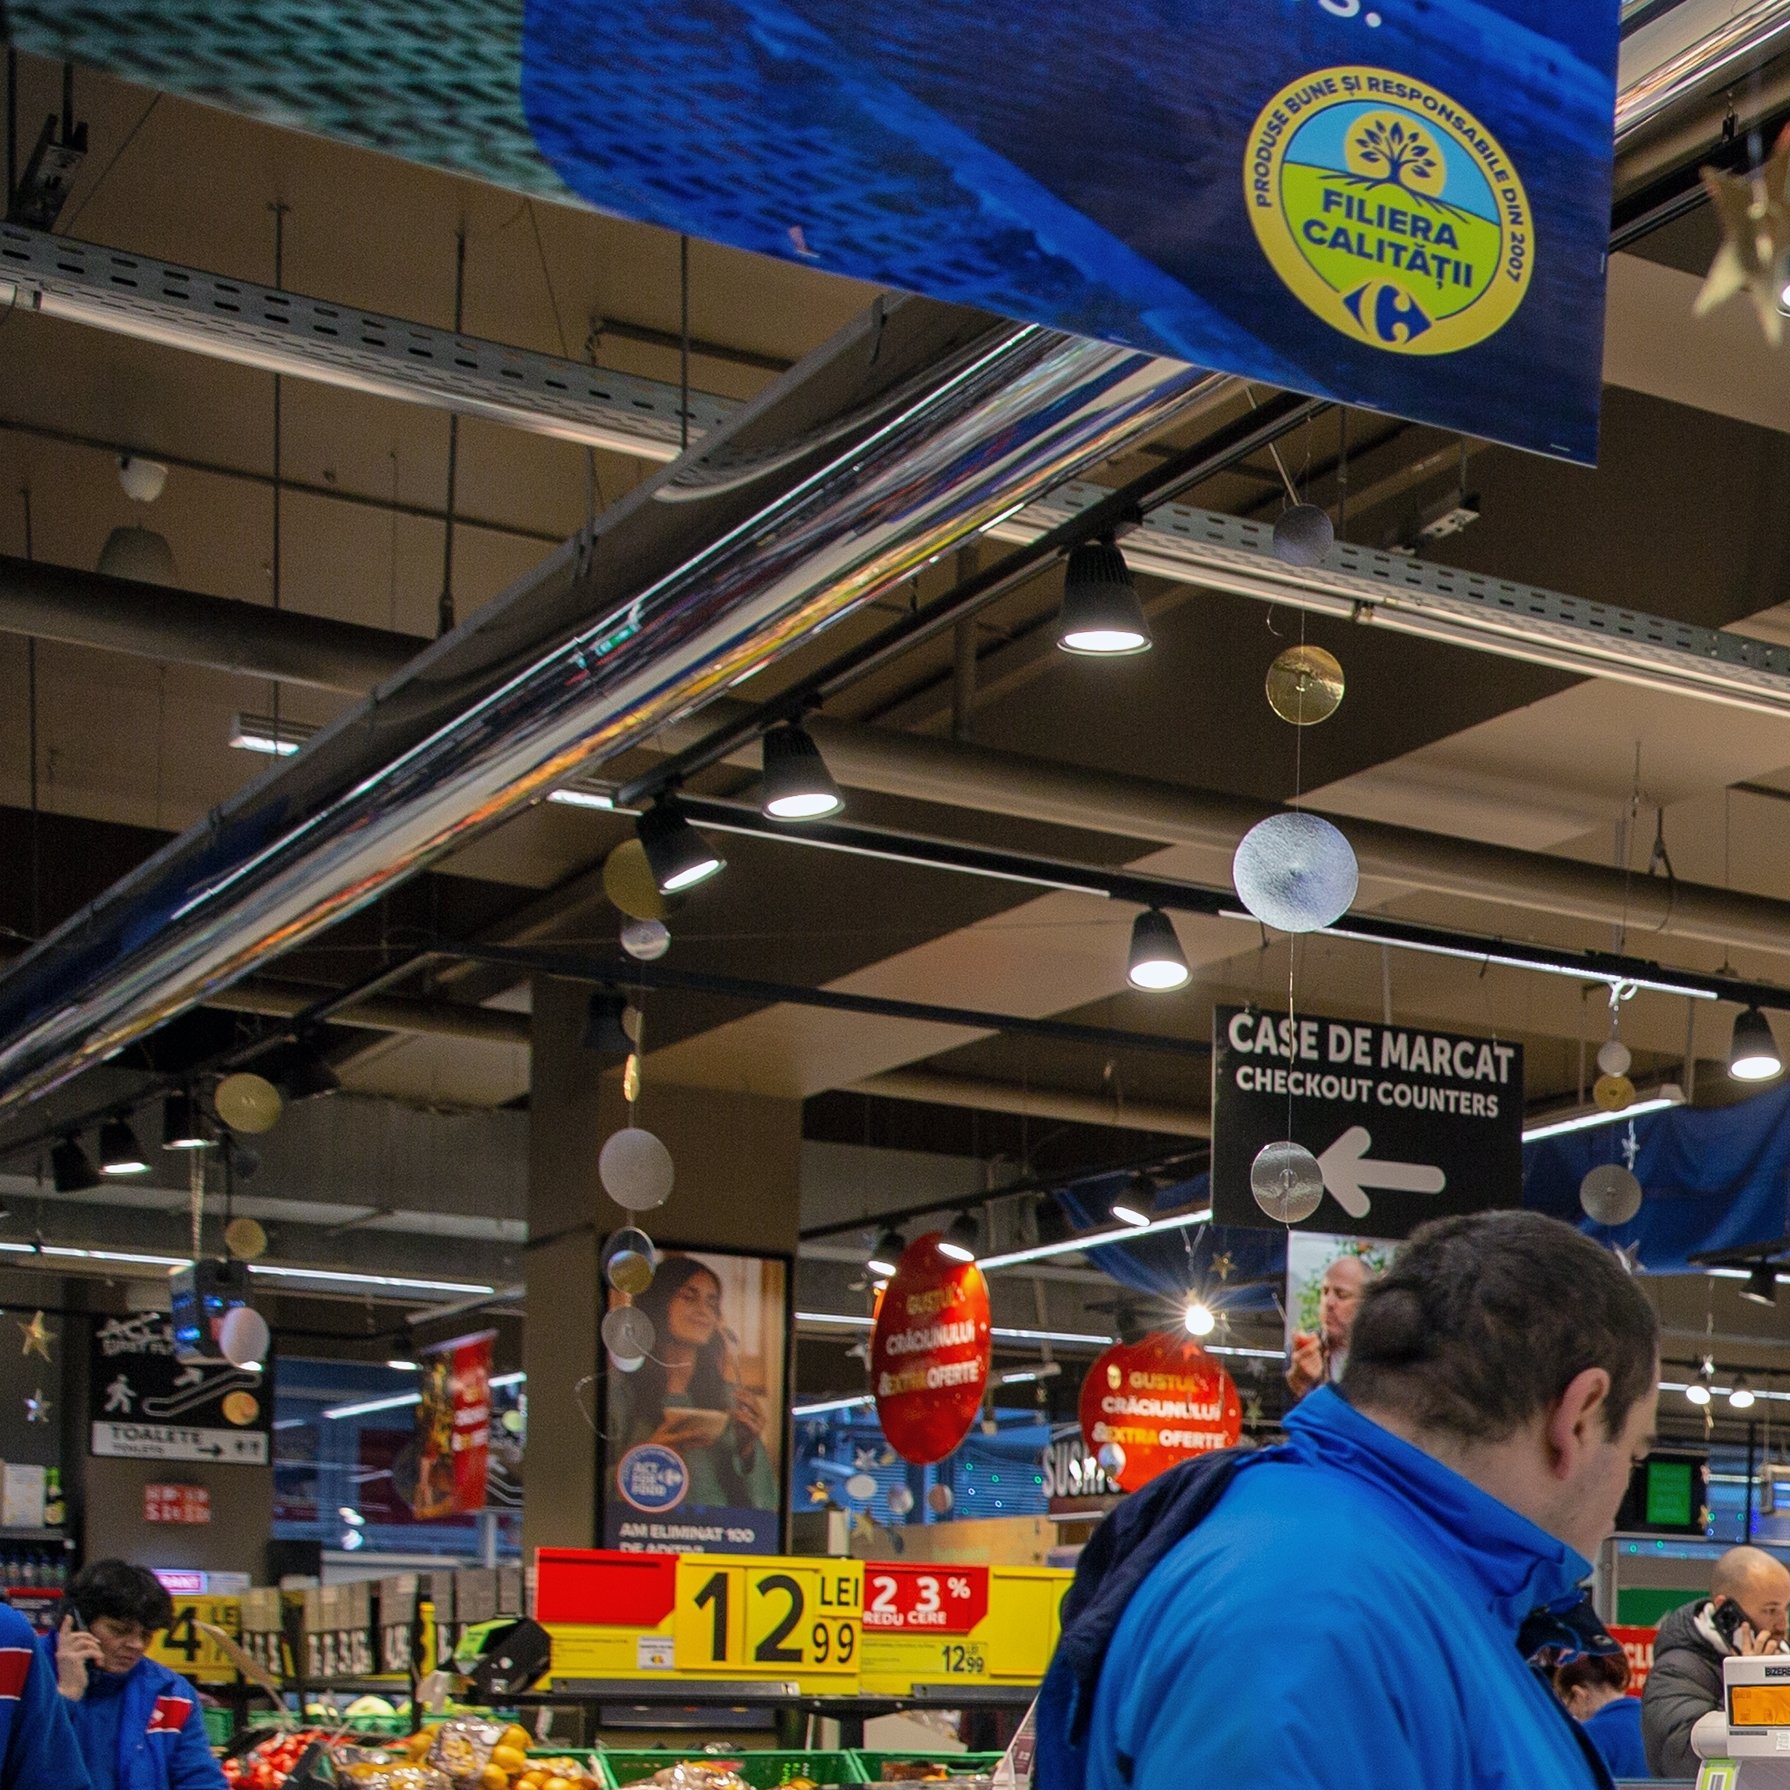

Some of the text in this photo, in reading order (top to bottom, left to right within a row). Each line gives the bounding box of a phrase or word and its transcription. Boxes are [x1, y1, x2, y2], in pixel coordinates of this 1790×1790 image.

[1286, 76, 1338, 115] BUNE
[1254, 105, 1292, 208] PRODUSE
[1367, 76, 1509, 184] RESPONSABILE
[1322, 187, 1460, 251] FILIERA
[1501, 186, 1525, 227] DIN
[1504, 230, 1526, 284] 2007
[1228, 1012, 1515, 1084] CASE DE MARCAT
[1235, 1065, 1500, 1119] CHECKOUT COUNTERS
[692, 1570, 806, 1665] 12
[819, 1574, 861, 1608] LEI
[810, 1620, 854, 1666] 99
